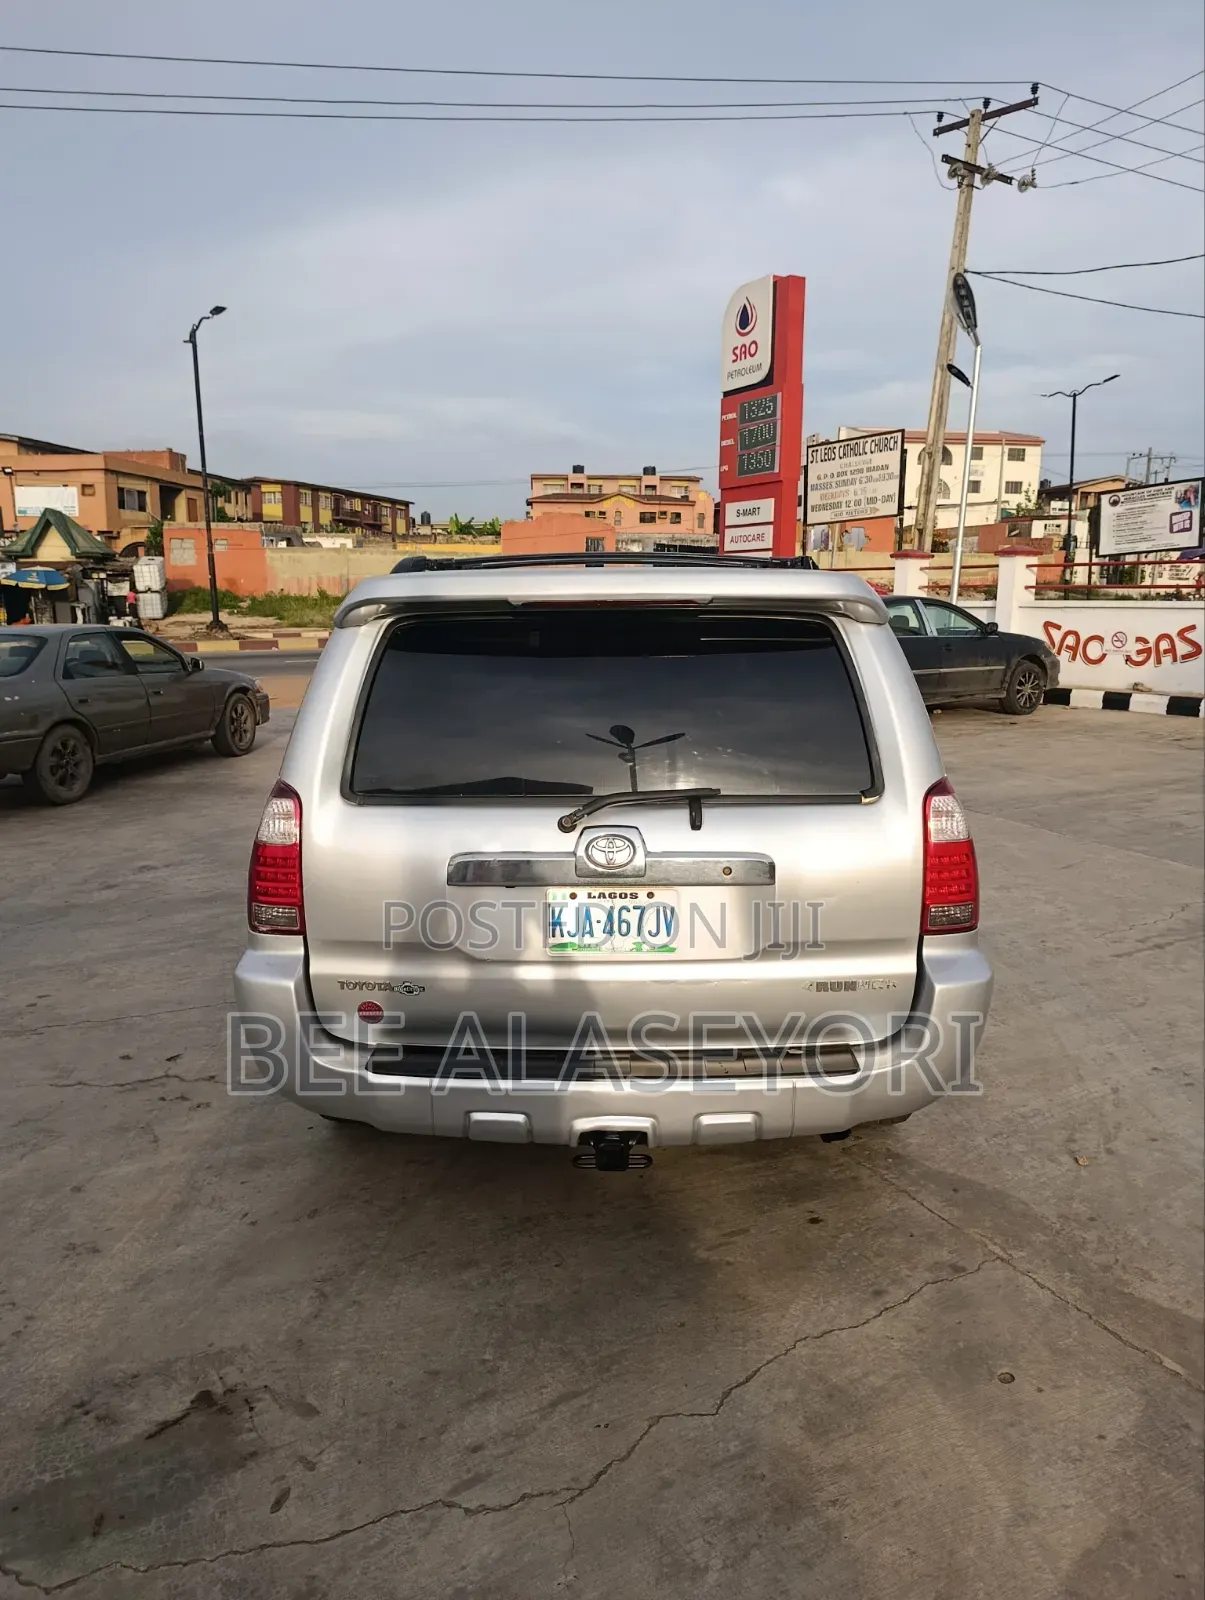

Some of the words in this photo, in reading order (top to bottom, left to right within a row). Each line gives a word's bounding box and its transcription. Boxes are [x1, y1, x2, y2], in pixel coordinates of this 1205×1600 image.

[731, 340, 758, 363] SAO
[727, 362, 762, 381] PETROLEUM
[743, 396, 773, 419] 1325
[743, 423, 773, 444] 1700
[838, 440, 868, 460] CATHOLIC
[870, 435, 898, 454] CHURCH
[742, 449, 772, 470] 1350
[836, 470, 848, 478] BOX
[866, 464, 890, 474] IBADAN
[835, 477, 858, 488] SUNDAY
[736, 506, 761, 518] S-MART
[810, 500, 843, 512] WEDNESDAY
[730, 532, 766, 544] AUTOCARE
[1043, 620, 1108, 666] SAO
[1124, 624, 1202, 668] GAS
[587, 892, 639, 900] LAGOS
[338, 980, 393, 992] TOYOTA
